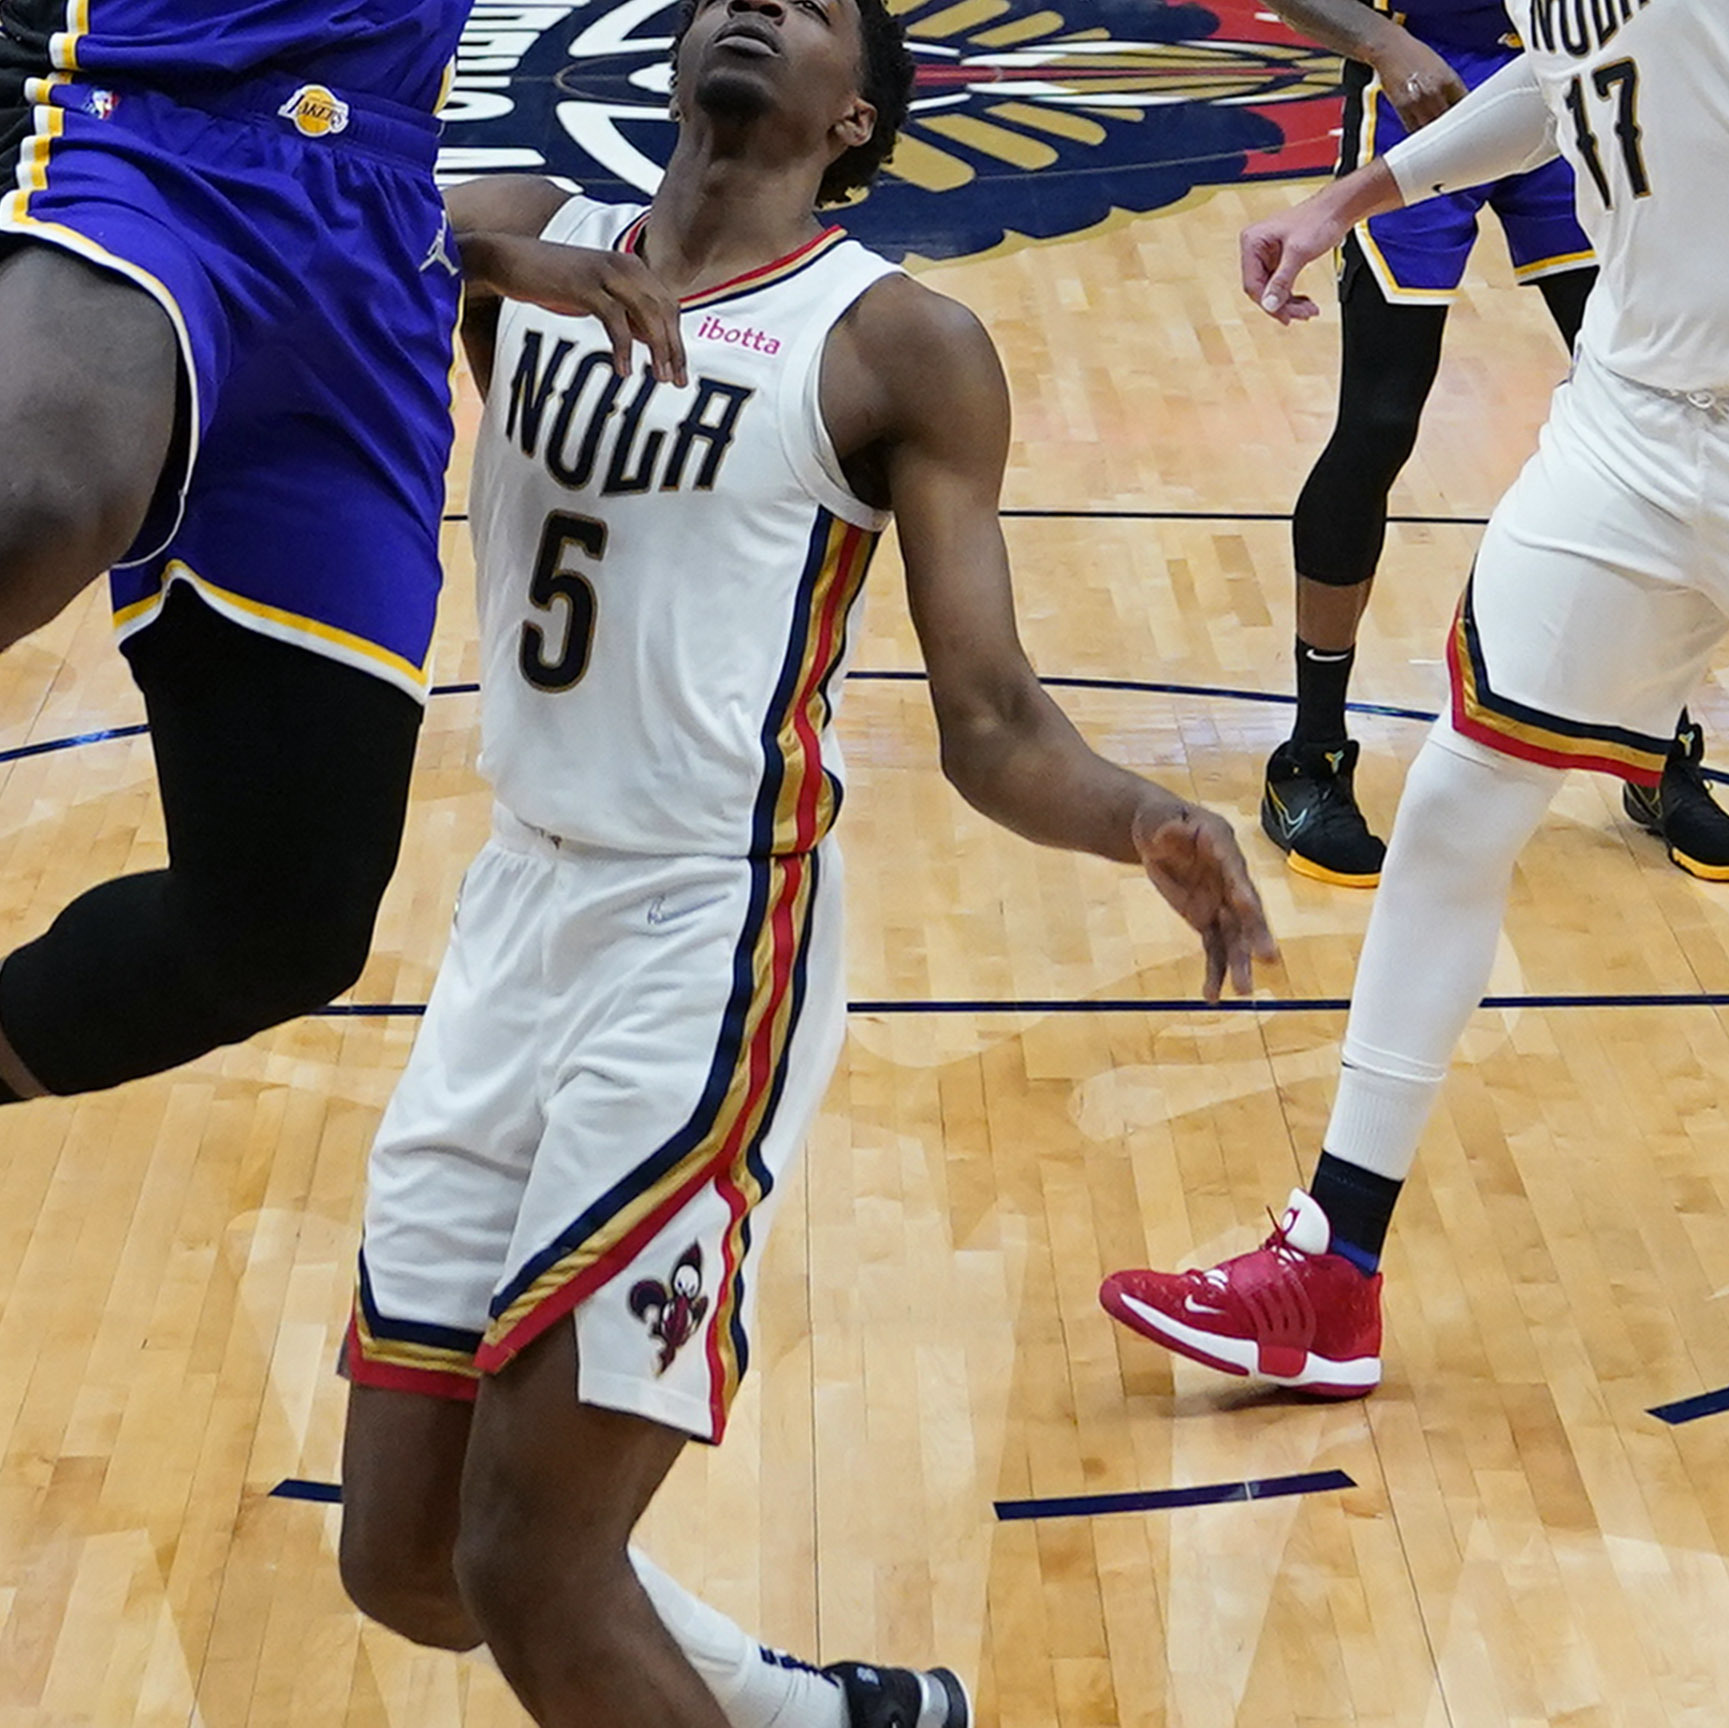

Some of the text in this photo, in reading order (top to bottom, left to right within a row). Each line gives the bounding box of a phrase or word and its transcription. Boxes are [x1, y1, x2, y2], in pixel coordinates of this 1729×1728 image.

[1563, 57, 1651, 211] 17
[506, 330, 758, 497] NOLA
[697, 316, 782, 357] ibotta
[519, 508, 609, 694] 5
